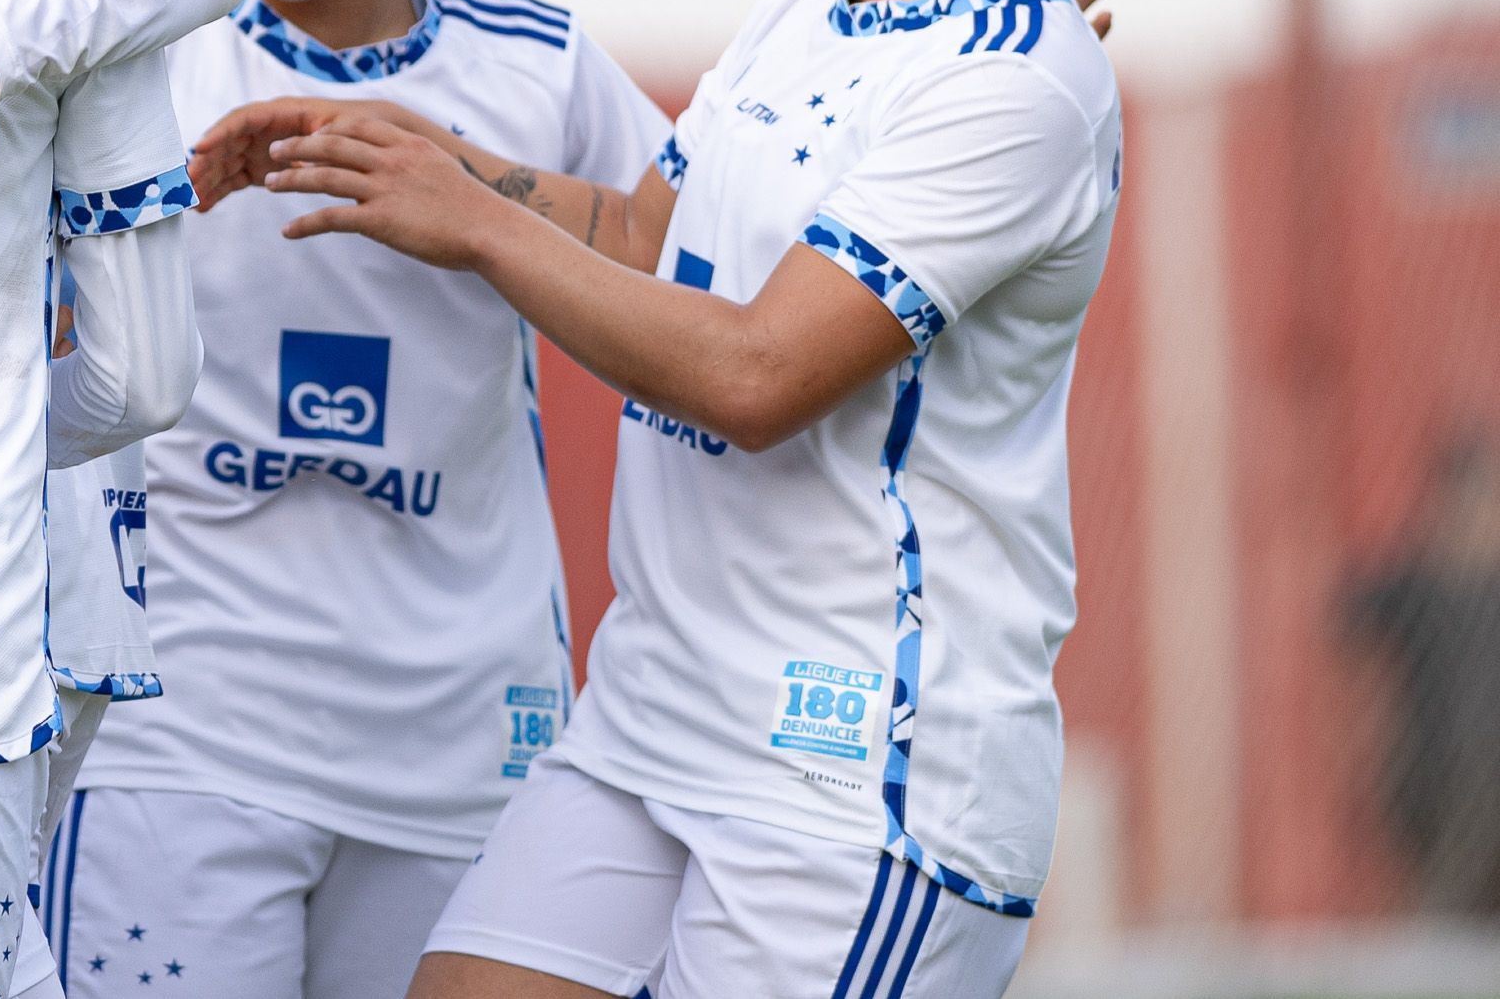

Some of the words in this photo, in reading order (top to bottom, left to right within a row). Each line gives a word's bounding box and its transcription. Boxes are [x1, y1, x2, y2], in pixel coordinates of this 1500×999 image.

[794, 662, 849, 683] LIGUE
[785, 682, 867, 725] 180
[781, 718, 862, 742] DENUNCIE
